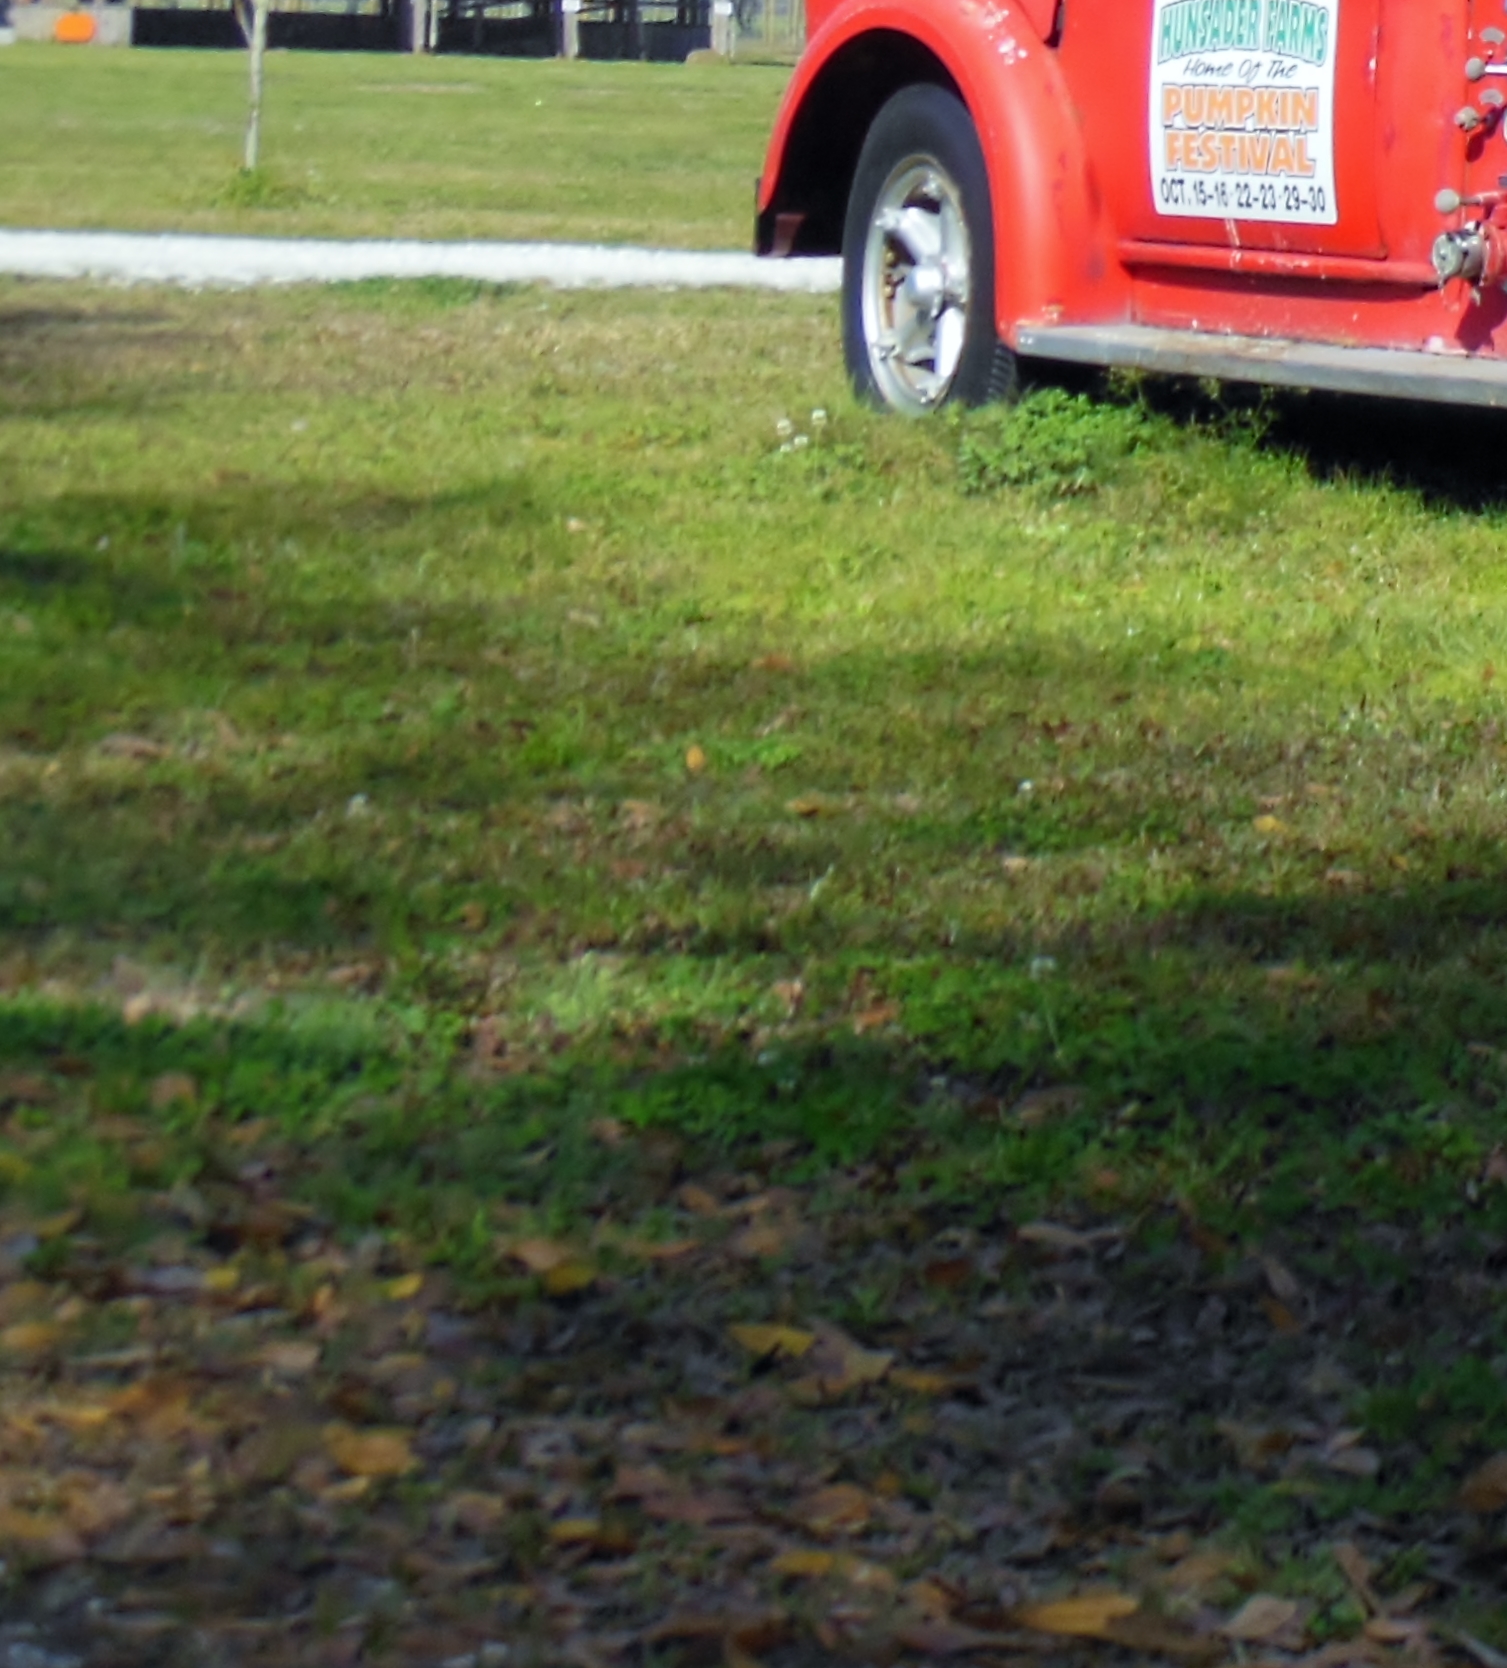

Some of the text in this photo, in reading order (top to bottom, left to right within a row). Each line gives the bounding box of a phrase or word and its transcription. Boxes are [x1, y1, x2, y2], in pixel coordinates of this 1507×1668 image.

[1183, 58, 1298, 84] Home Of The
[1162, 82, 1319, 132] PUMPKIN
[1164, 129, 1316, 177] FESTIVAL
